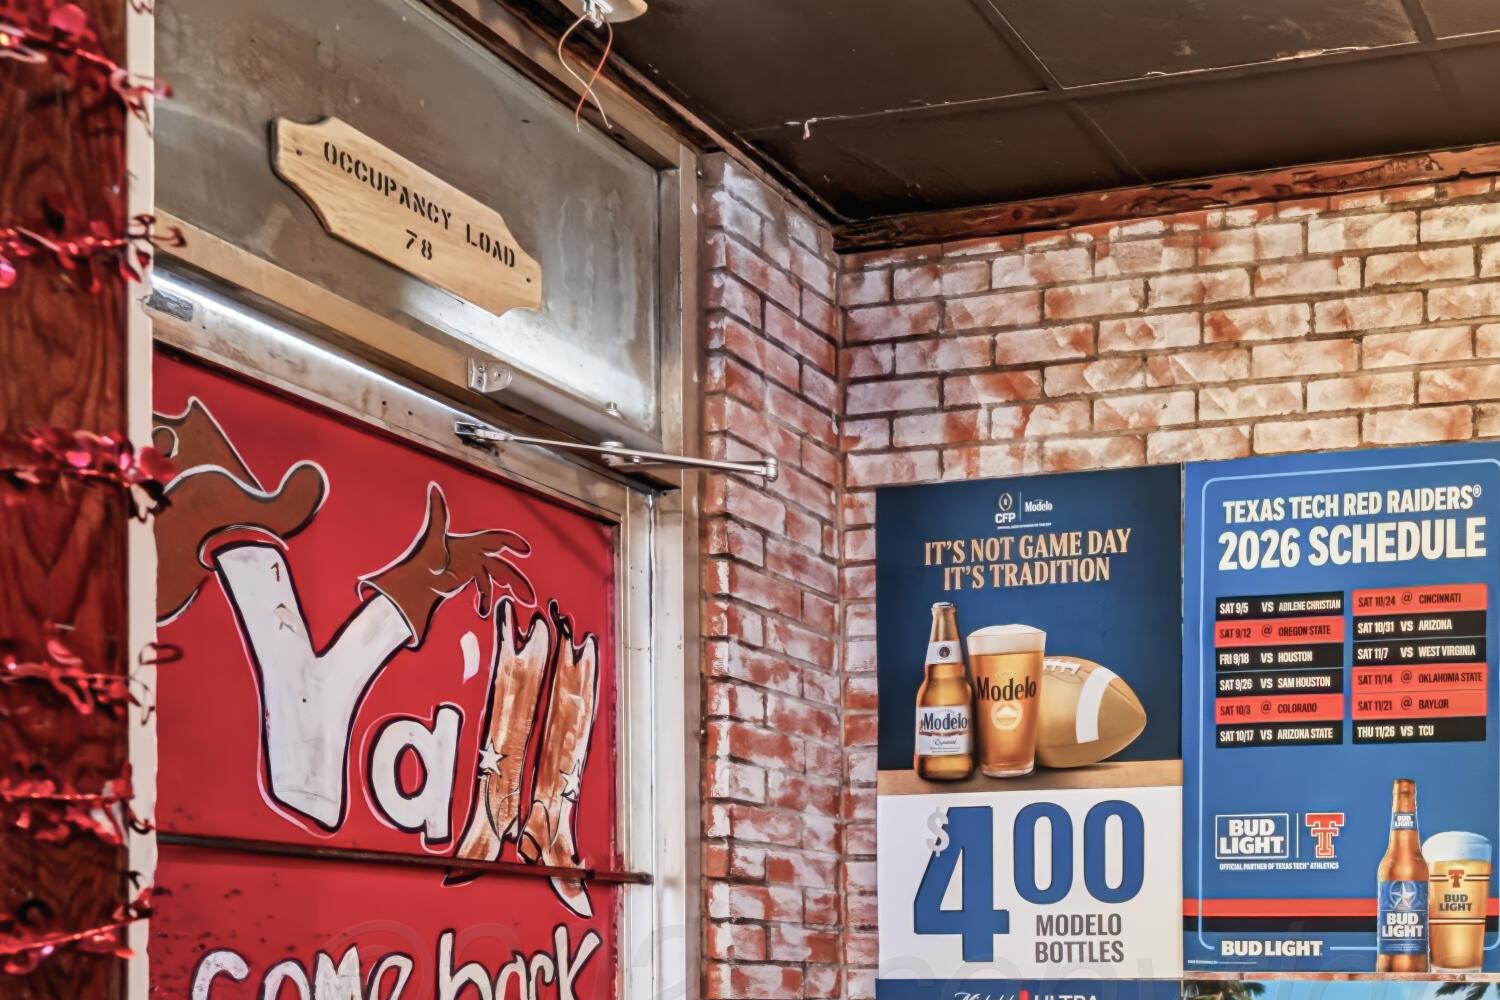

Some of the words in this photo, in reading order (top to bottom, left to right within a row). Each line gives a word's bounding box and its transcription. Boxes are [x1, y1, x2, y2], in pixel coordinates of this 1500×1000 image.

[323, 141, 452, 231] OCCUPANCY
[465, 222, 517, 269] LOAD
[404, 229, 434, 262] 78
[1024, 500, 1053, 513] Modelo
[1222, 497, 1285, 524] TEXAS
[1288, 494, 1339, 520] TECH
[1343, 491, 1383, 516] RED
[995, 512, 1016, 524] CFP
[923, 540, 966, 566] IT'S
[970, 536, 1015, 563] NOT
[1019, 531, 1083, 560] GAME
[1087, 527, 1132, 556] DAY
[1217, 527, 1301, 571] 2026
[1307, 516, 1487, 567] SCHEDULE
[943, 564, 985, 591] IT'S
[990, 556, 1111, 588] TRADITION
[1357, 622, 1373, 634] SAT
[1373, 621, 1395, 633] 10/31
[1400, 620, 1414, 632] VS
[1418, 619, 1453, 631] ARIZONA
[1357, 648, 1373, 661] SAT
[1373, 647, 1389, 660] 11/7
[1400, 647, 1414, 658] VS
[1418, 646, 1440, 658] WEST
[1441, 644, 1476, 657] VIRGINIA
[976, 675, 1037, 701] Modelo
[1219, 679, 1234, 691] SAT
[1234, 678, 1253, 690] 9/26
[1260, 677, 1273, 689] VS
[1277, 677, 1296, 689] SAM
[1296, 675, 1331, 688] HOUSTON
[922, 712, 968, 731] Modelo
[1219, 731, 1234, 743] SAT
[1235, 730, 1254, 742] 10/17
[1260, 729, 1273, 741] VS
[1277, 728, 1310, 740] ARIZONA
[1311, 727, 1333, 739] STATE
[1357, 726, 1374, 738] THU
[1374, 725, 1396, 738] 11/26
[1400, 725, 1414, 737] VS
[1418, 725, 1435, 737] TCU
[1228, 818, 1276, 837] BUD
[1219, 836, 1285, 855] LIGHT
[1443, 893, 1469, 902] BUD
[1439, 902, 1473, 912] LIGHT
[1035, 913, 1122, 937] MODELO
[1386, 912, 1419, 925] BUD
[1381, 925, 1424, 938] LIGHT
[1035, 940, 1125, 964] BOTTLES
[1221, 940, 1264, 957] BUD
[1264, 940, 1324, 957] LIGHT
